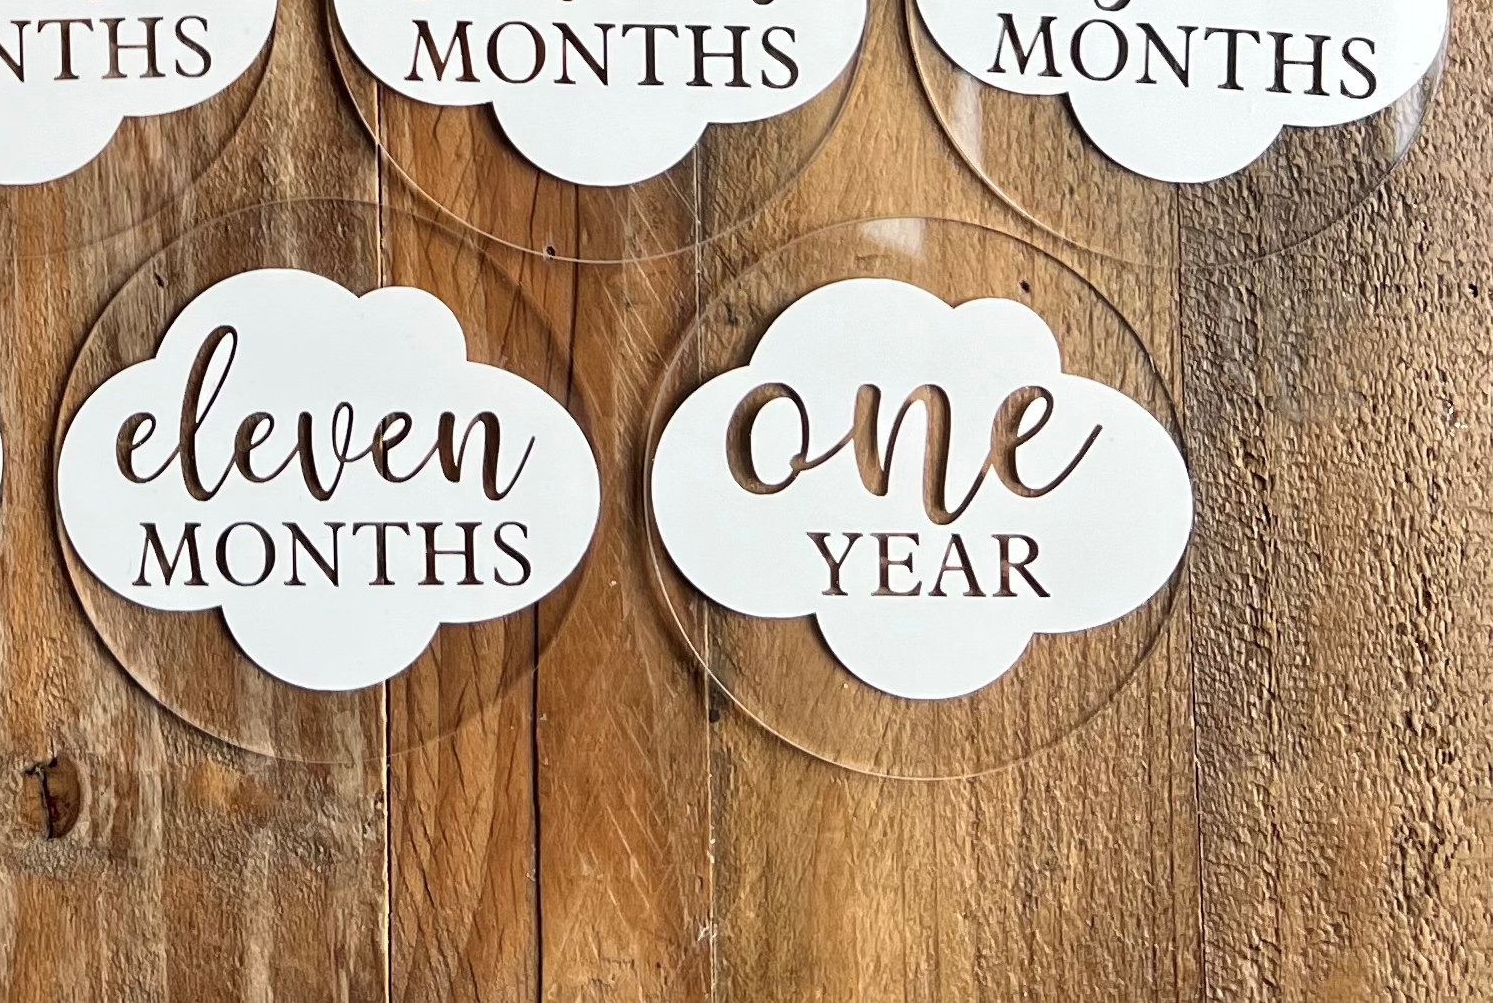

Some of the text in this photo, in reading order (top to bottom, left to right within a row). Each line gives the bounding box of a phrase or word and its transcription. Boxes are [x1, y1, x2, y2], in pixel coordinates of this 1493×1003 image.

[404, 20, 798, 89] MONTHS
[987, 13, 1376, 99] MONTHS
[116, 325, 535, 501] eleven
[726, 383, 1102, 525] one
[132, 522, 531, 587] MONTHS
[807, 532, 1050, 597] YEAR
